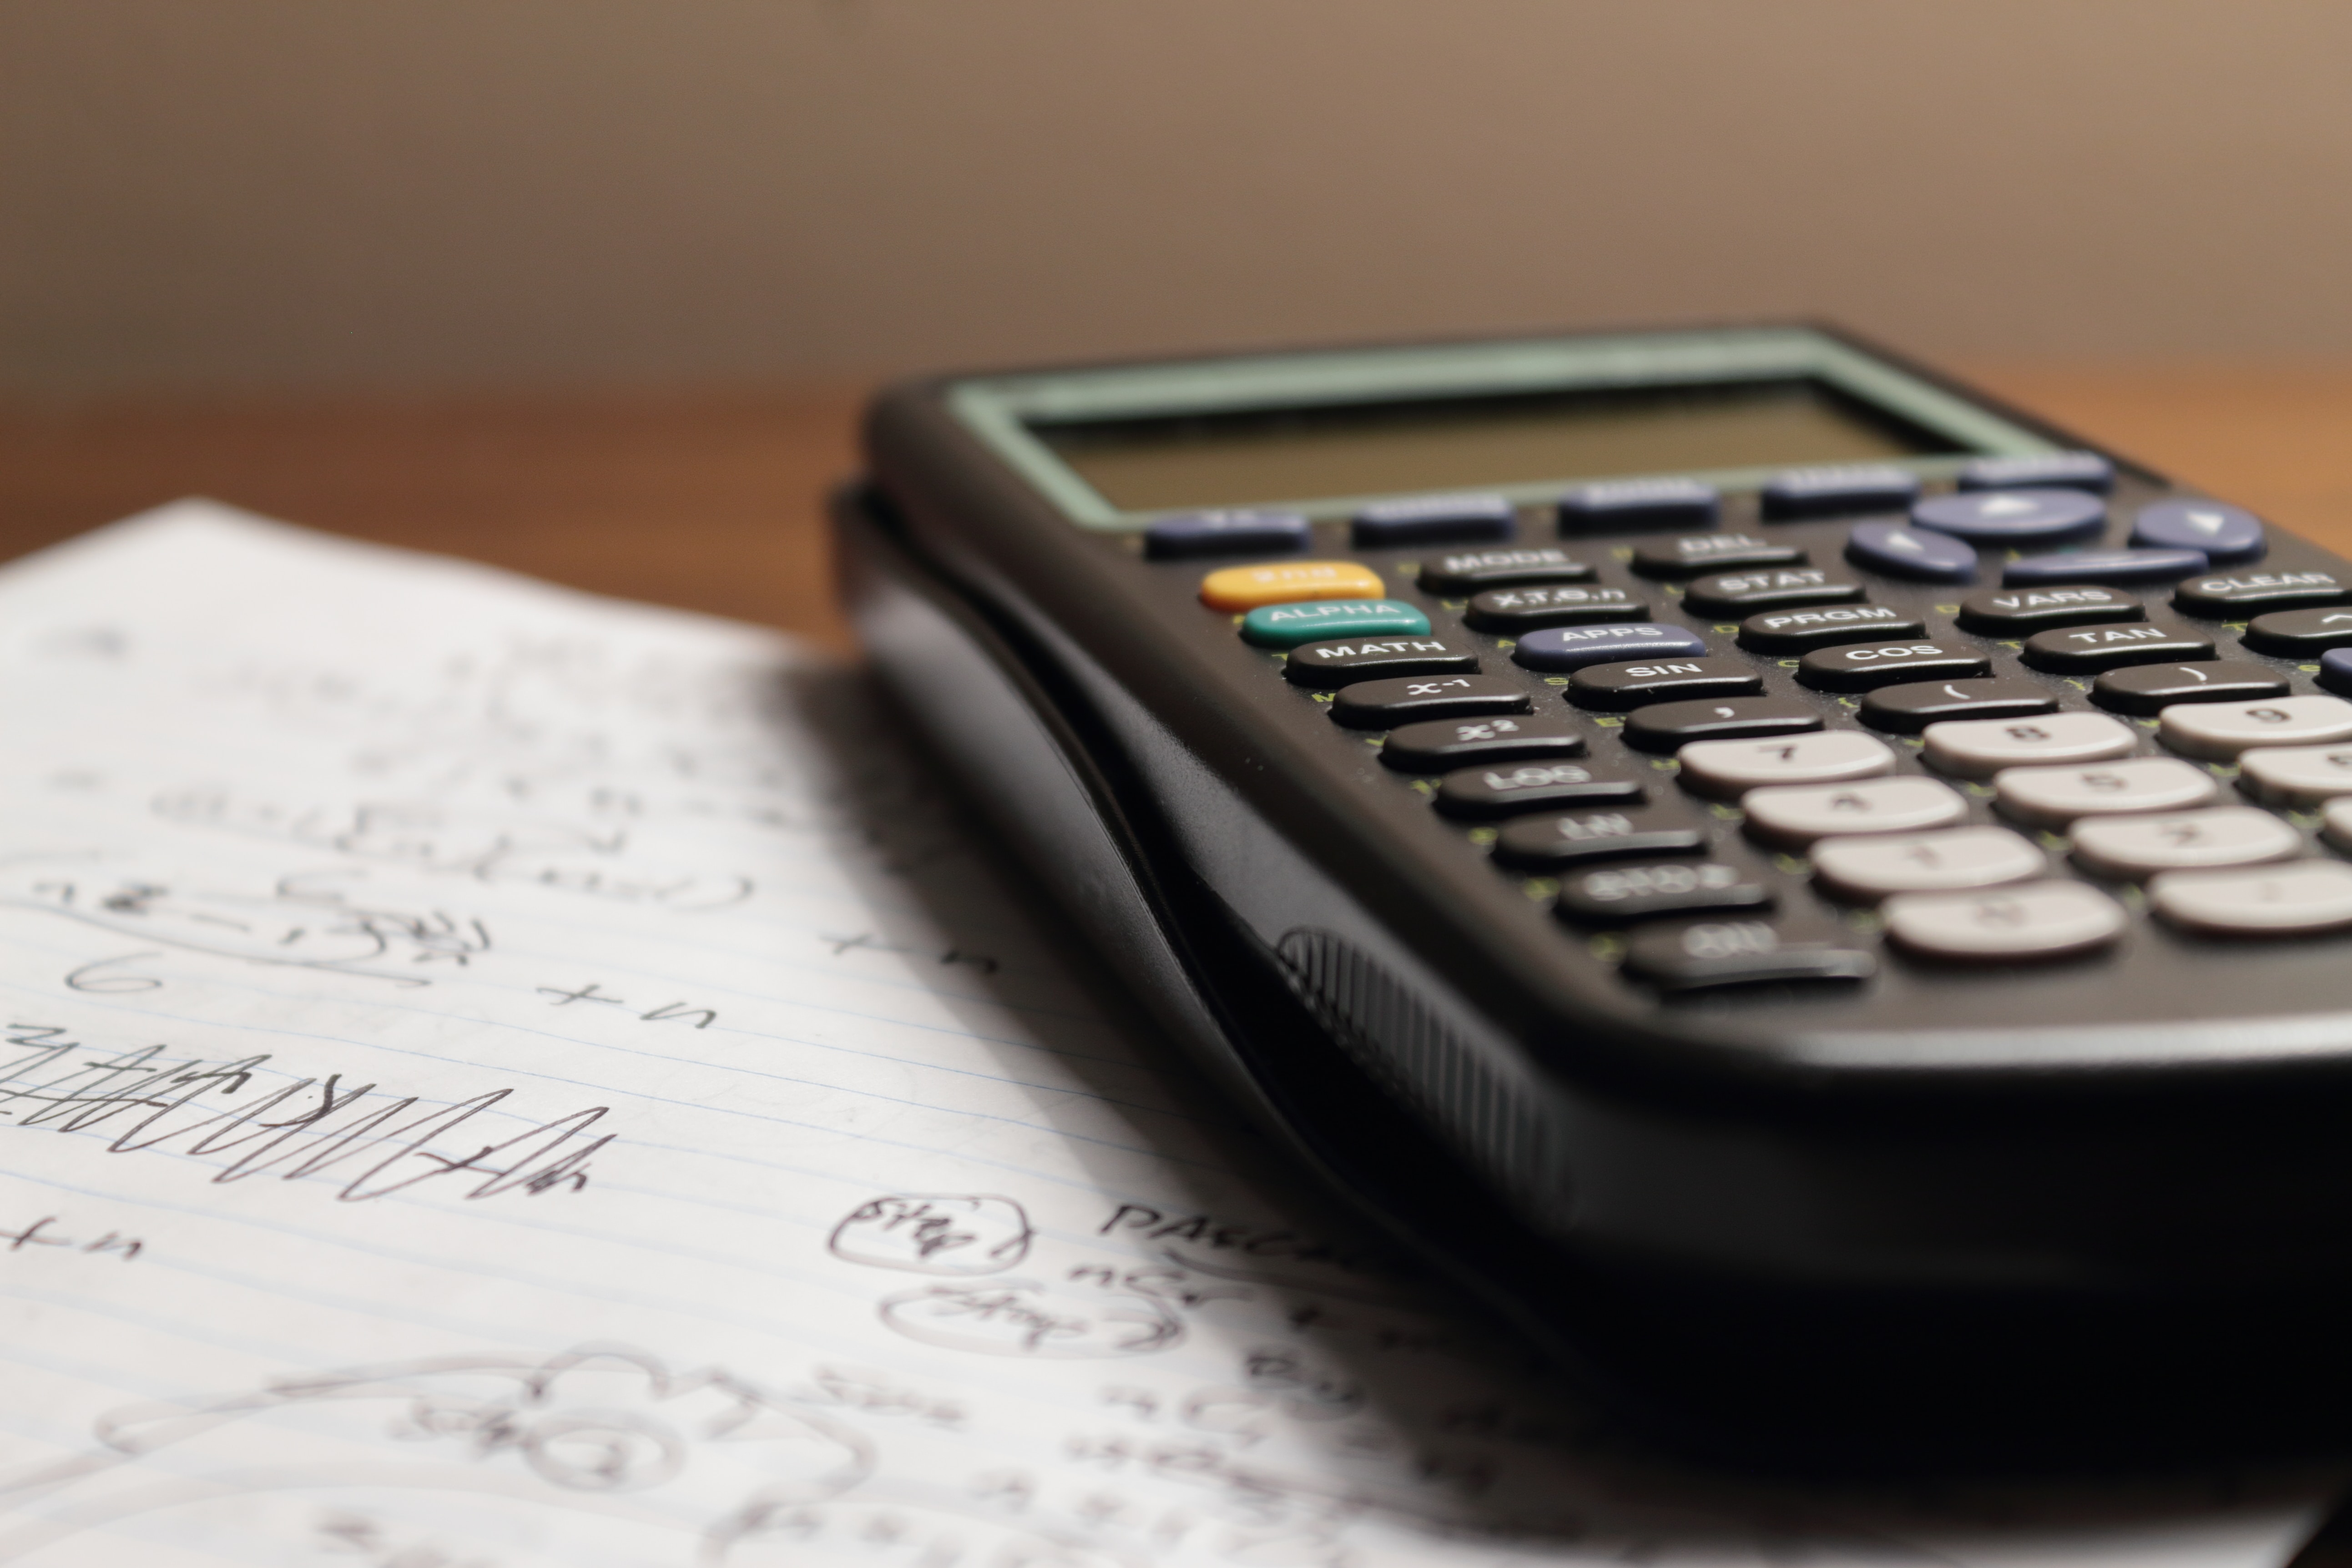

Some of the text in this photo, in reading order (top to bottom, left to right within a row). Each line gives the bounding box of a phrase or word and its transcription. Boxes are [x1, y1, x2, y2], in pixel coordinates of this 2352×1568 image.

[1679, 534, 1767, 555] DEL
[1445, 550, 1568, 572] MODE
[1719, 570, 1825, 590] STAT
[2201, 573, 2335, 591] CLEAR
[1993, 591, 2112, 608] VARS
[1270, 604, 1401, 621] ALPHA
[1764, 608, 1897, 628] PRGM
[1562, 626, 1663, 641] APPS
[2069, 628, 2167, 642] TAN
[1316, 642, 1446, 658] MATH
[1846, 645, 1943, 660] COS
[1625, 664, 1702, 676] SIN
[1757, 743, 1797, 762] 7
[1483, 765, 1592, 790] LOG
